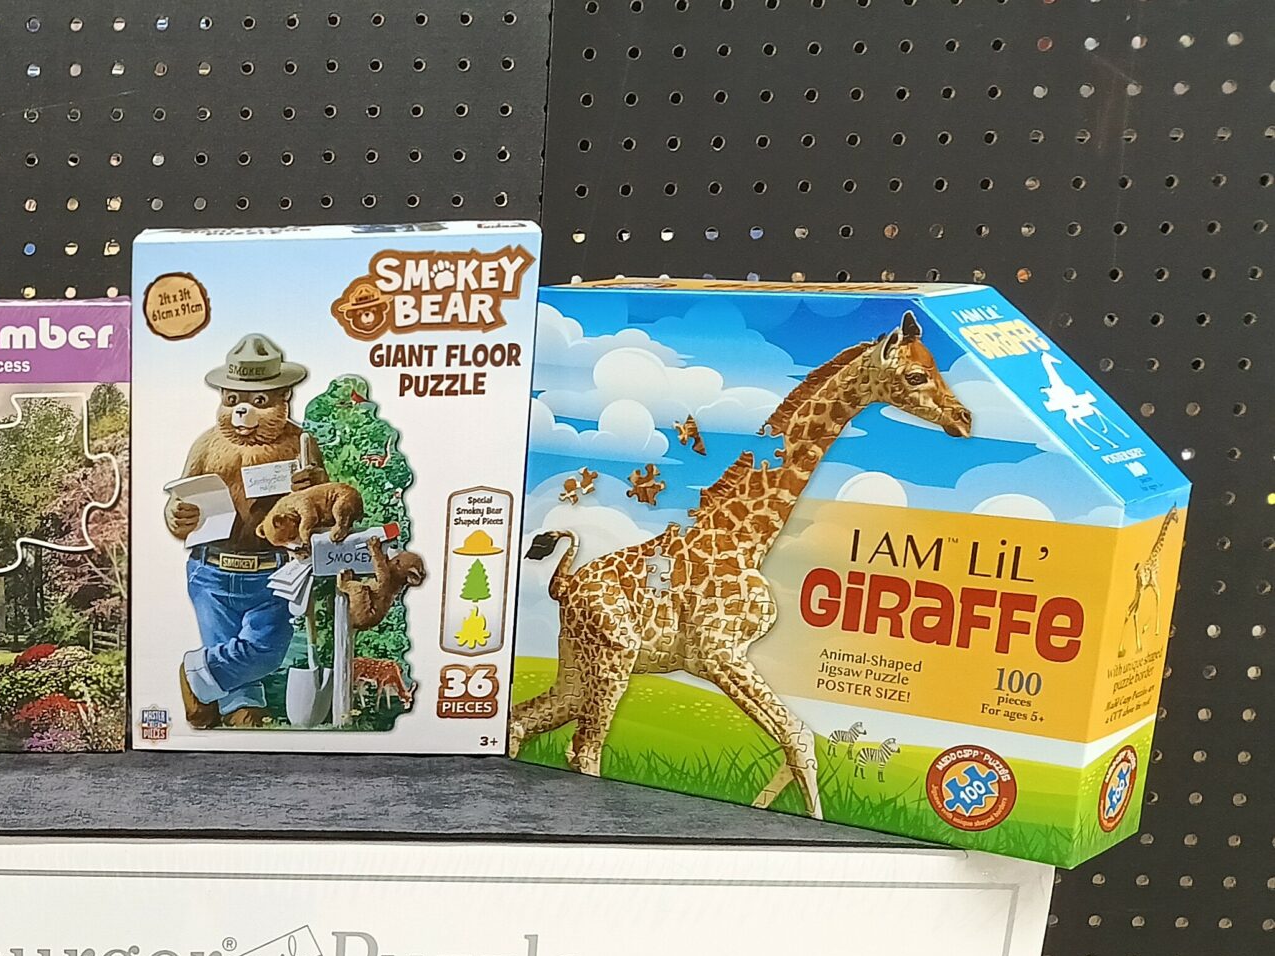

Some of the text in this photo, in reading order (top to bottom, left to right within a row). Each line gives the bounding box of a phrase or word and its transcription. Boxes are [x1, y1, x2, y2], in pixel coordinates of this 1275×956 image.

[158, 287, 192, 306] 2ft x 3ft
[152, 302, 204, 322] 61cm x 91cm
[394, 291, 496, 327] BEAR
[369, 343, 522, 368] GIANT FLOOR
[228, 362, 267, 377] SMOKEY
[399, 372, 487, 397] PUZZLE
[468, 496, 493, 506] Special
[456, 506, 503, 517] Smokey Bear
[454, 517, 481, 527] Shaped
[850, 529, 860, 563] I
[222, 556, 256, 570] SMOKEY
[820, 648, 922, 673] Animal-Shaped
[443, 667, 493, 699] 36
[818, 661, 910, 686] Jigsaw Puzzle
[994, 667, 1043, 697] 100
[816, 678, 911, 704] POSTER SIZE!
[997, 694, 1032, 708] pieces
[441, 701, 493, 715] PIECES
[980, 703, 1045, 723] For ages 5+
[479, 736, 499, 747] 3+
[959, 780, 986, 804] 100
